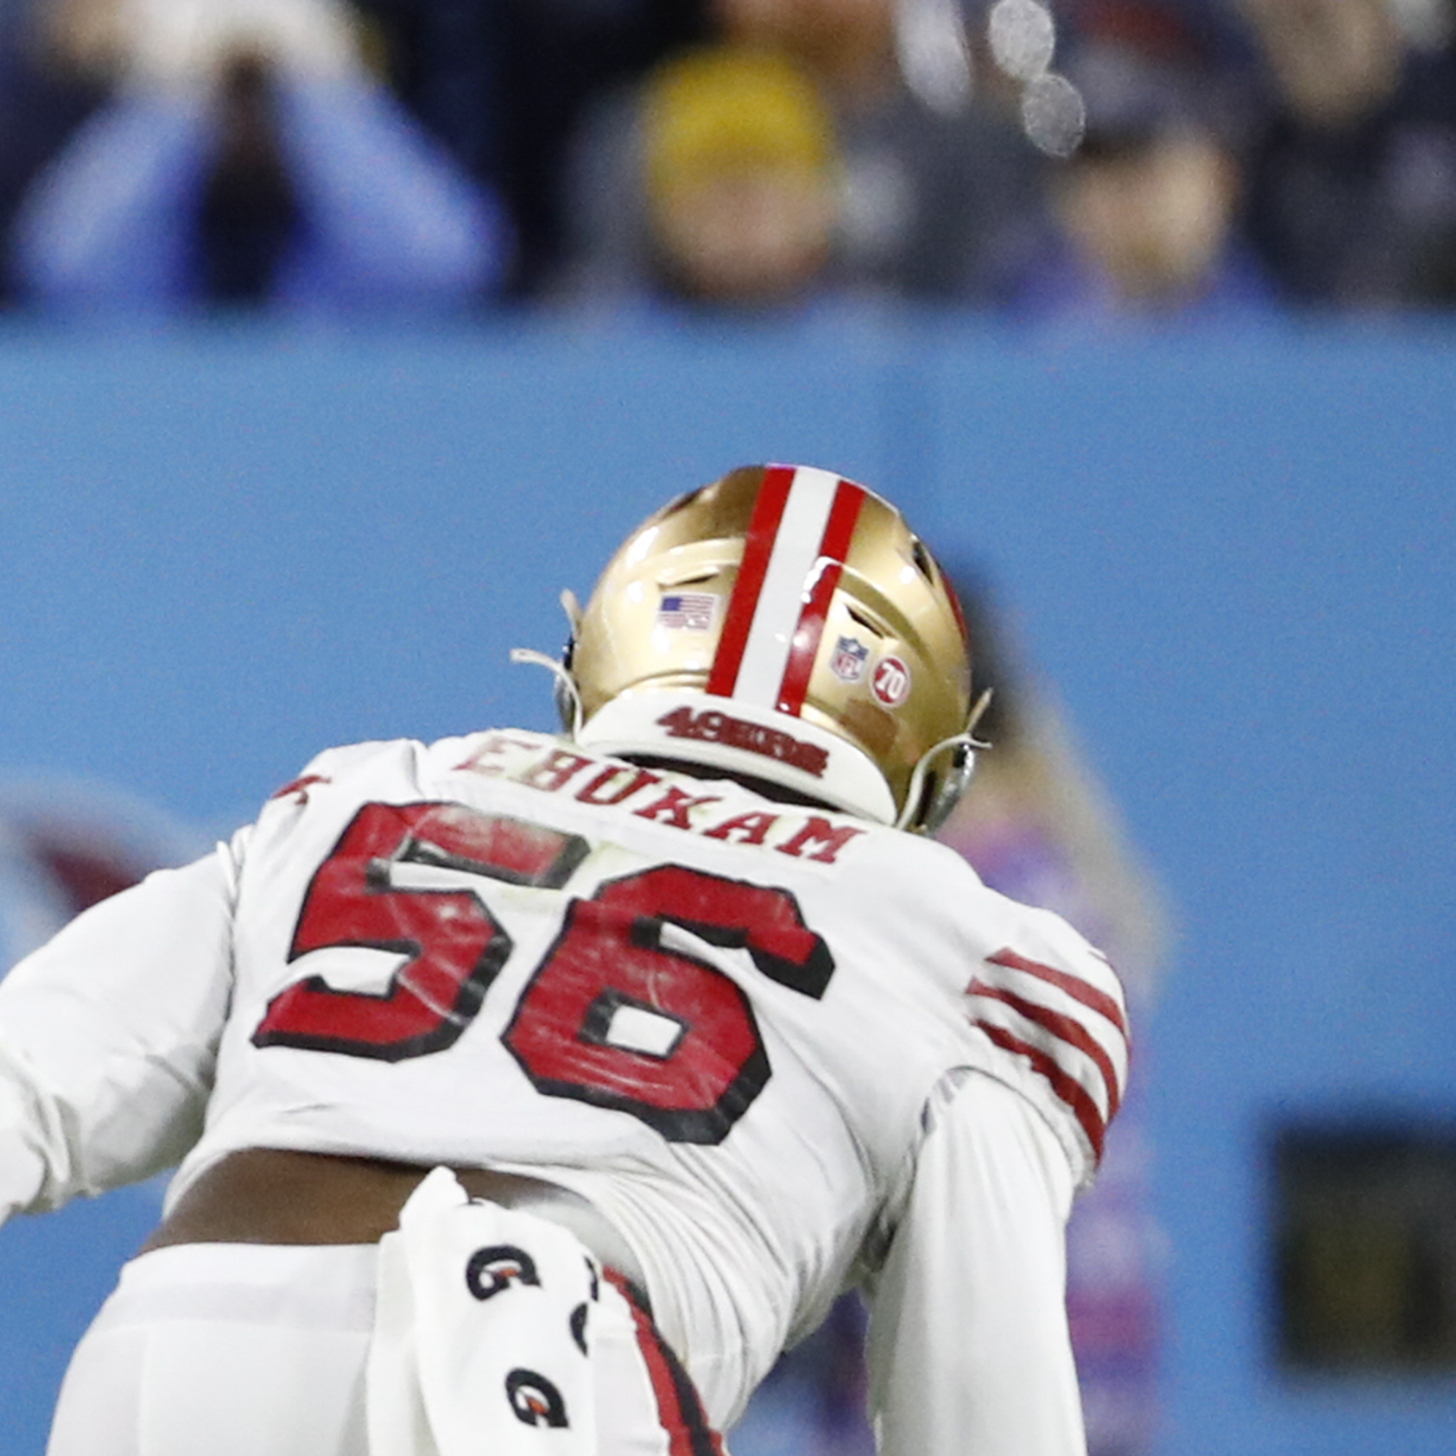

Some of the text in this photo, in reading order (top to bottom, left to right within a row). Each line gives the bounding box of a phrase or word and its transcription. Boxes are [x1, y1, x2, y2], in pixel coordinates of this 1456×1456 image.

[875, 661, 907, 700] 70
[452, 735, 866, 864] EBUKAM
[250, 801, 836, 1146] 56
